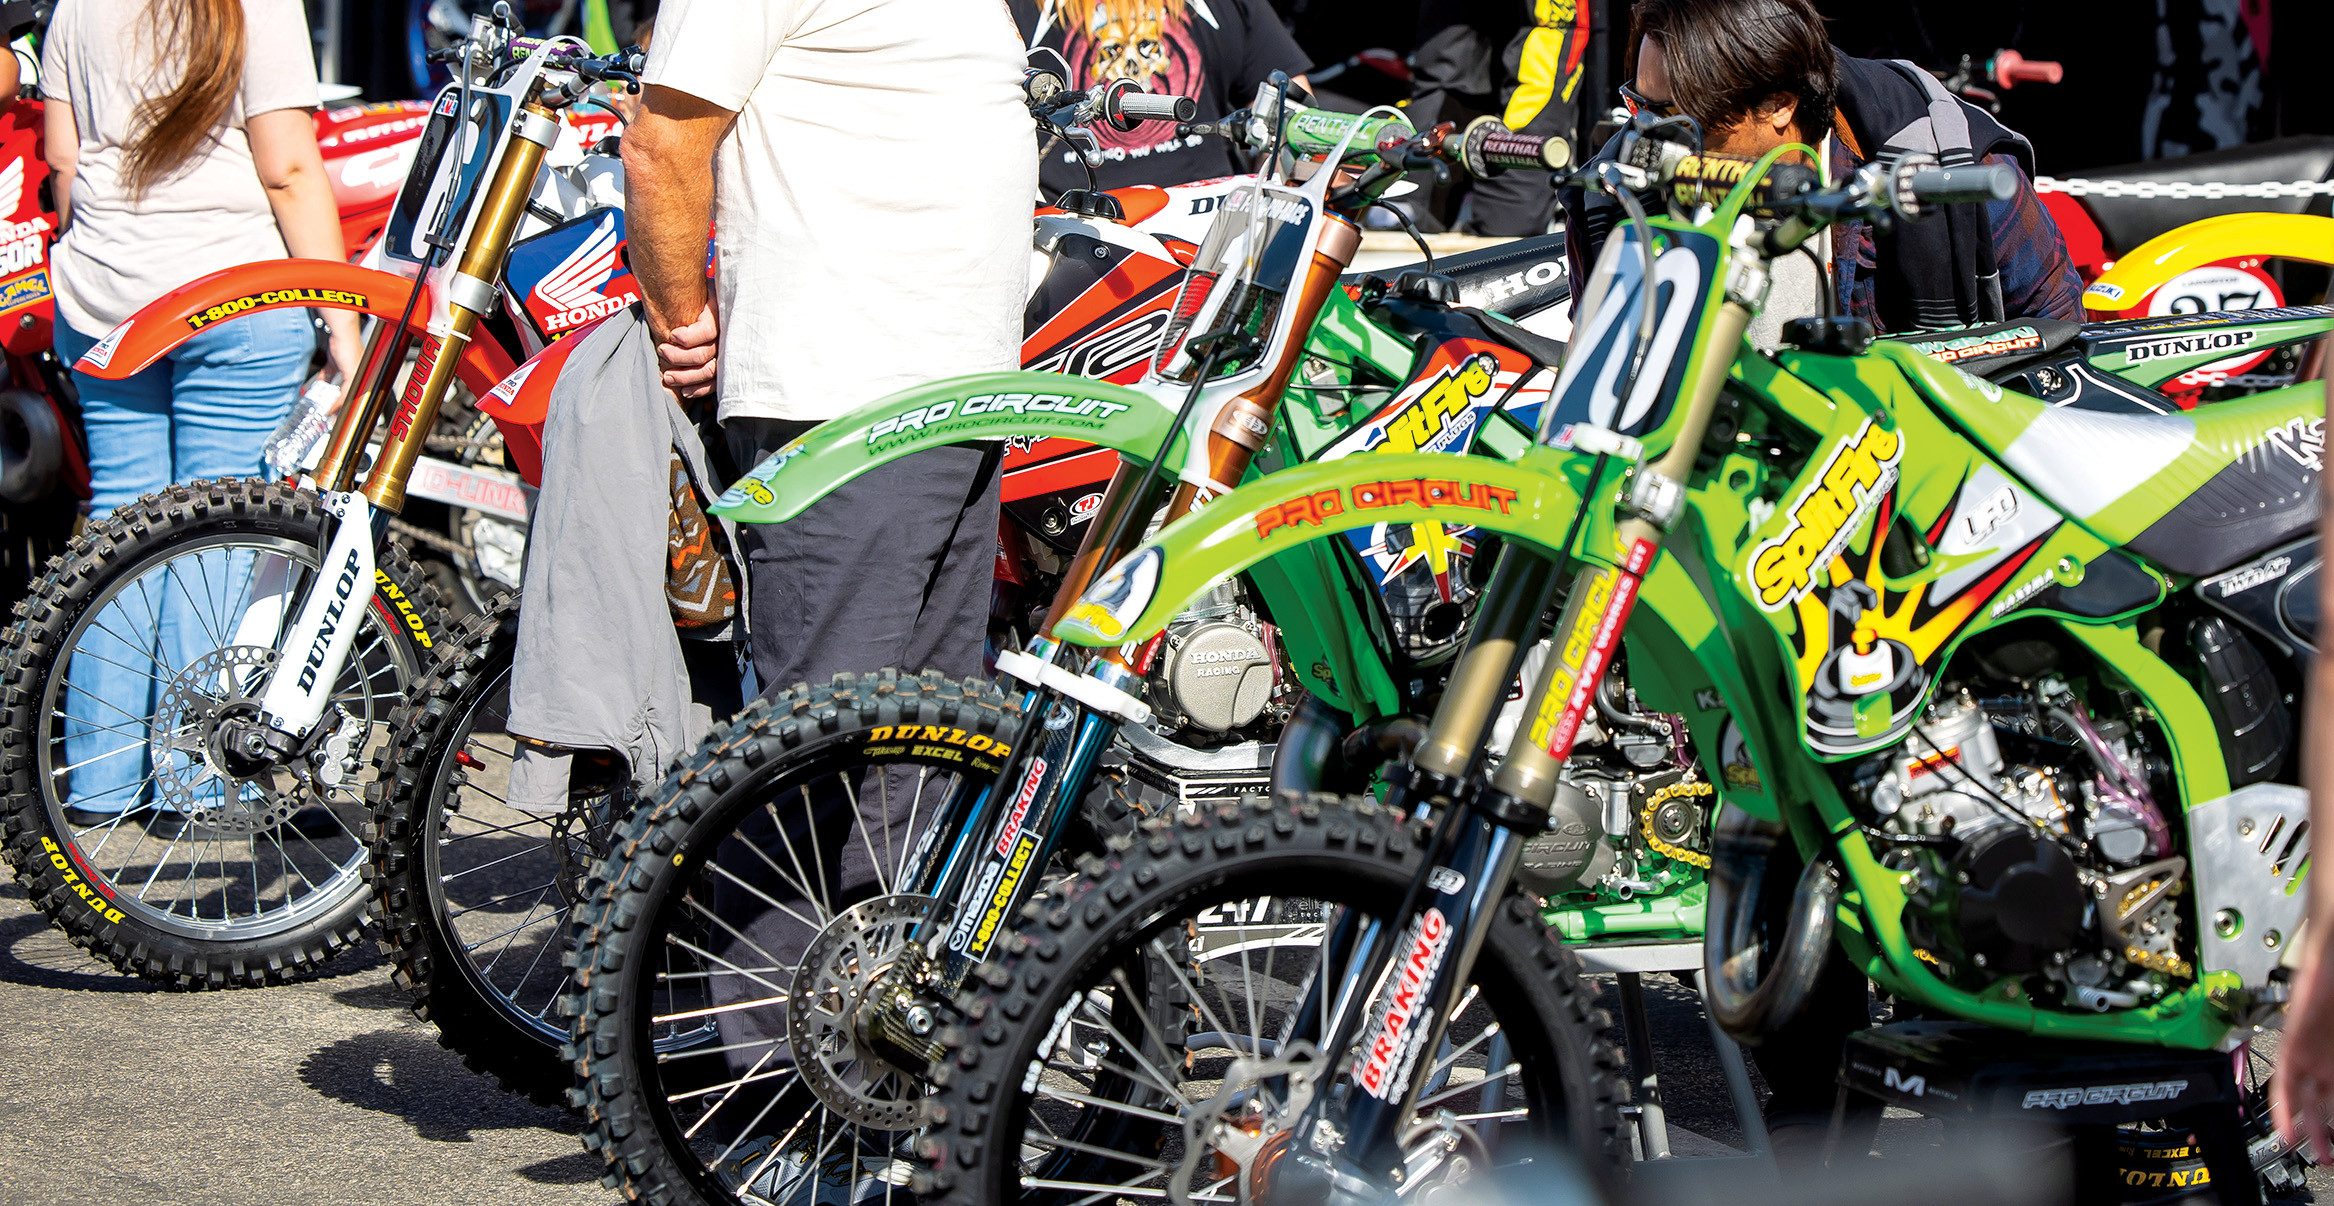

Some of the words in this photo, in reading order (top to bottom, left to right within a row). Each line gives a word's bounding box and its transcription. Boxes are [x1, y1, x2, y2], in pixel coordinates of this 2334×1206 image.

[1295, 114, 1369, 140] RENTHL
[1483, 140, 1541, 157] RENTHAL
[187, 289, 367, 328] 1-800-COLLECT
[545, 292, 640, 330] HONDA
[2129, 331, 2255, 362] DUNLOP
[390, 334, 442, 443] SHOWA
[867, 399, 958, 446] PRO
[959, 392, 1132, 419] CIRCUIT
[1254, 488, 1345, 540] PRO
[1350, 477, 1518, 516] CIRCUIT
[297, 547, 361, 697] DUNLOP
[1528, 667, 1575, 751] PRO
[1560, 528, 1629, 672] CIRCUT
[1191, 648, 1262, 665] HONDA
[1197, 666, 1241, 679] RACING
[866, 724, 1012, 759] DUNLOP
[911, 744, 964, 763] EXCEL
[998, 758, 1046, 856] BRAKING
[40, 836, 126, 925] DUNLOP
[959, 861, 1001, 934] mazda
[971, 836, 1035, 954] 1-800-COLLECT
[1299, 897, 1325, 911] elit
[1364, 916, 1442, 1090] BRAKING
[2022, 1087, 2085, 1110] PRO
[2083, 1080, 2189, 1106] CIRCUIT
